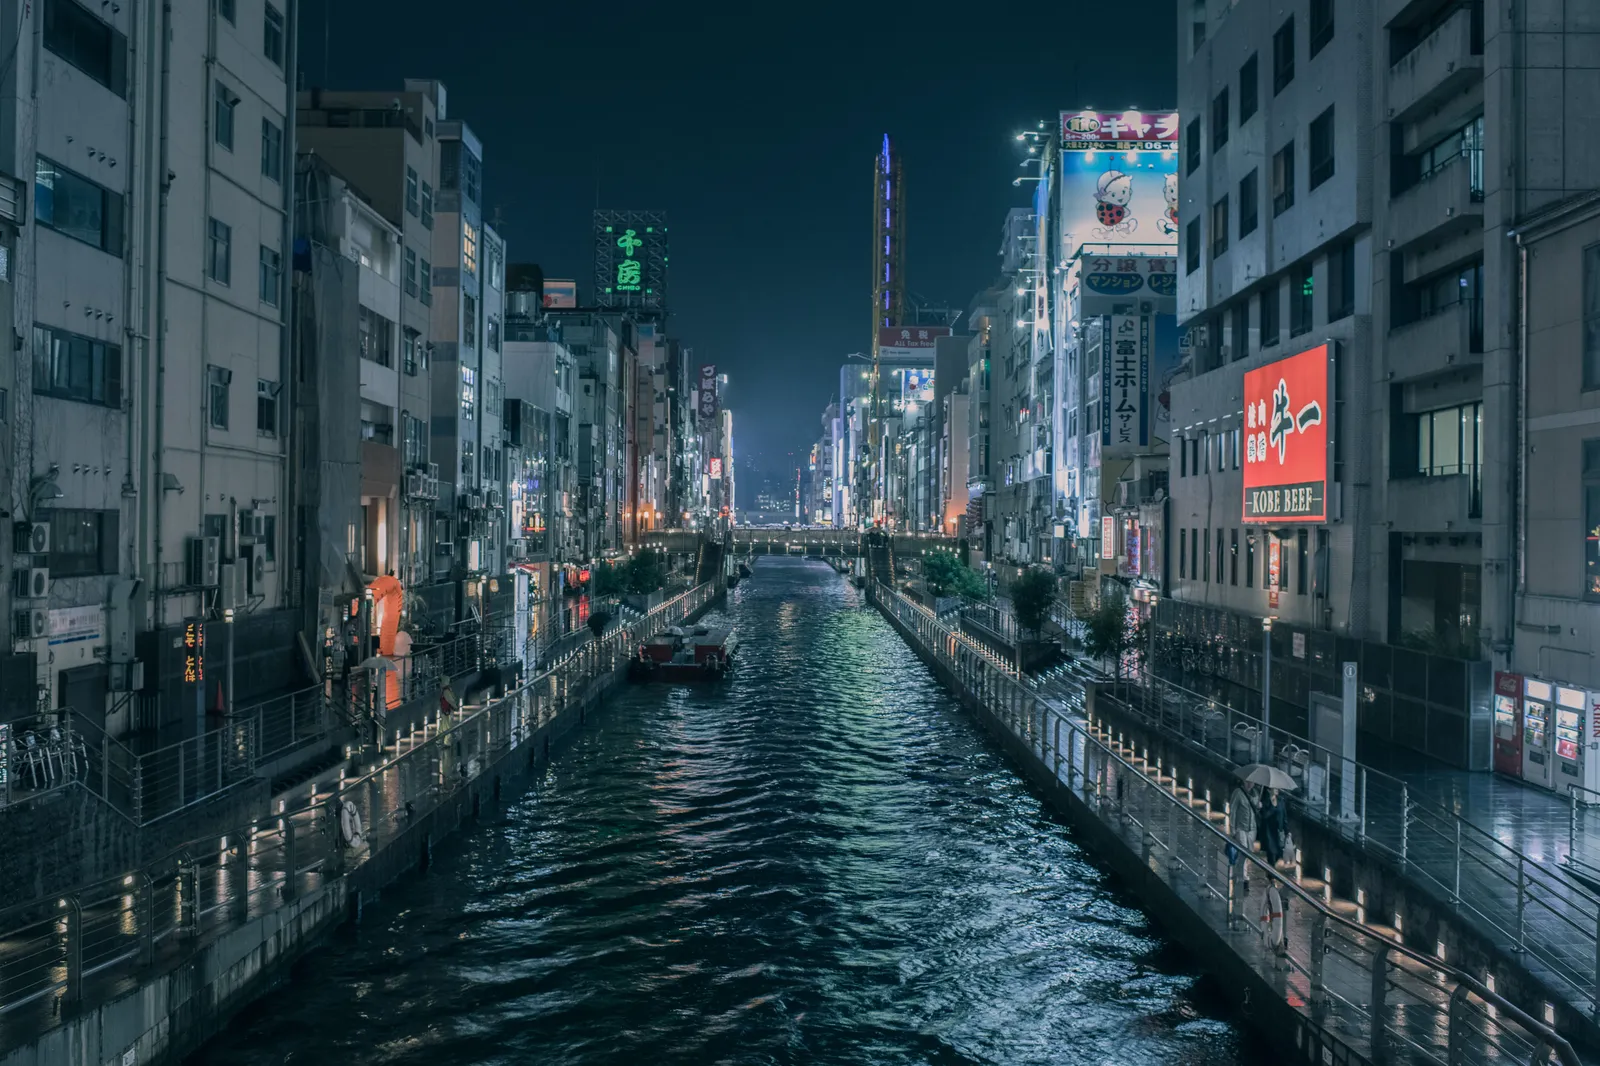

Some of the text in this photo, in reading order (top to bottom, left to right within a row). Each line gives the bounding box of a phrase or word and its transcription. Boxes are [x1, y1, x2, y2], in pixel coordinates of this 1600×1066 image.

[1089, 275, 1177, 288] マンション レジ
[1114, 339, 1137, 443] 富士ホームサービス
[1252, 486, 1313, 513] KOBE BEEF
